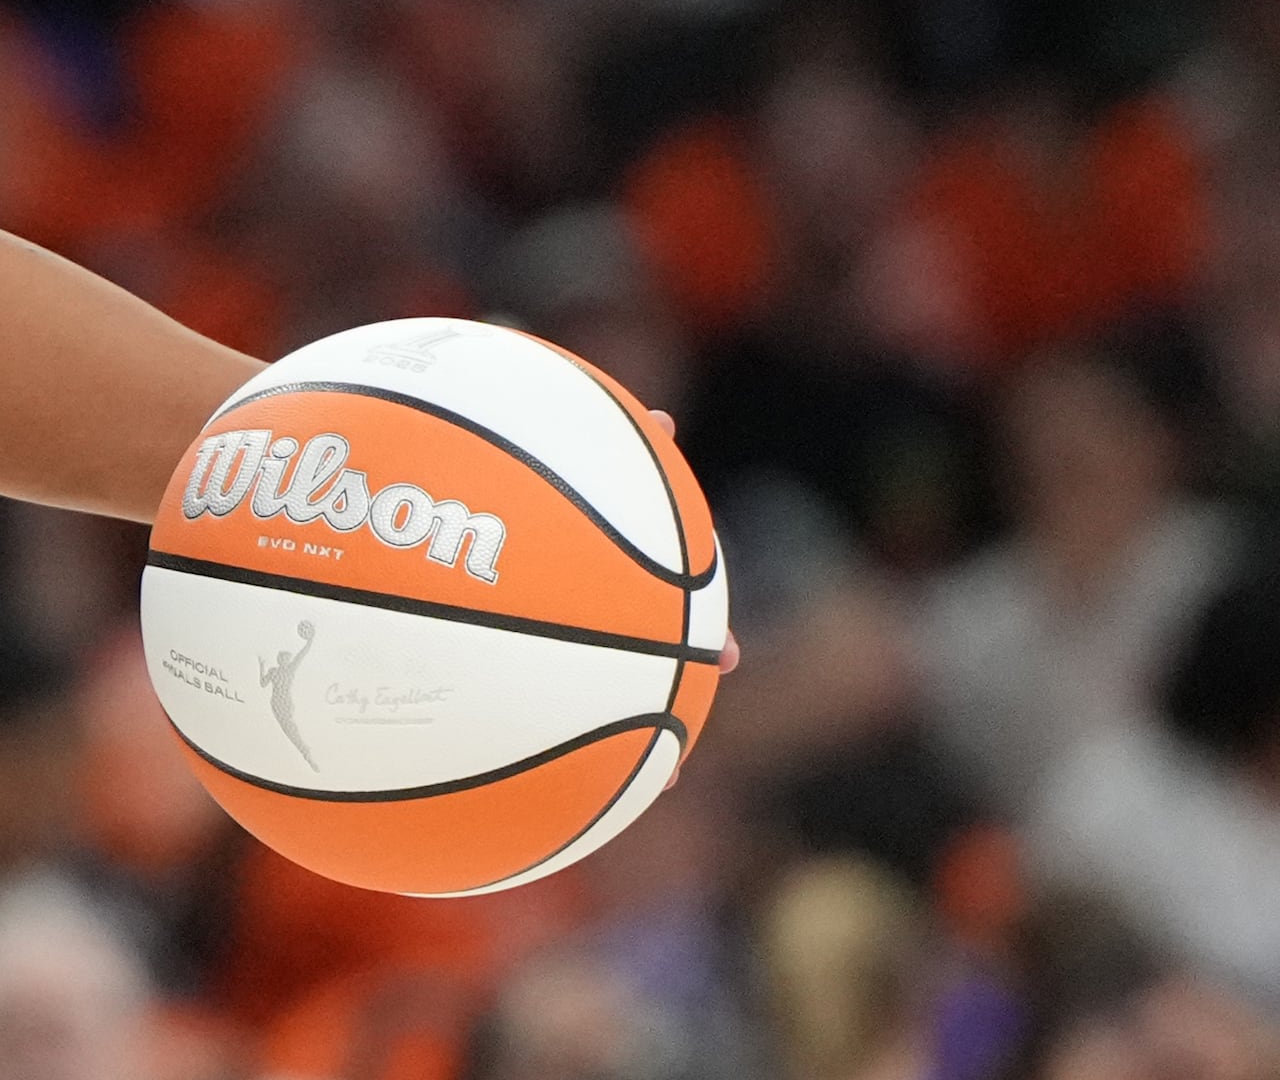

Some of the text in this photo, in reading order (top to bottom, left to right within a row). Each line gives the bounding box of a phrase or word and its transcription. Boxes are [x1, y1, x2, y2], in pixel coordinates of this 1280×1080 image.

[182, 429, 506, 585] Wilson
[303, 542, 345, 561] NXT
[169, 649, 229, 683] OFFICIAL
[204, 680, 245, 703] BALL
